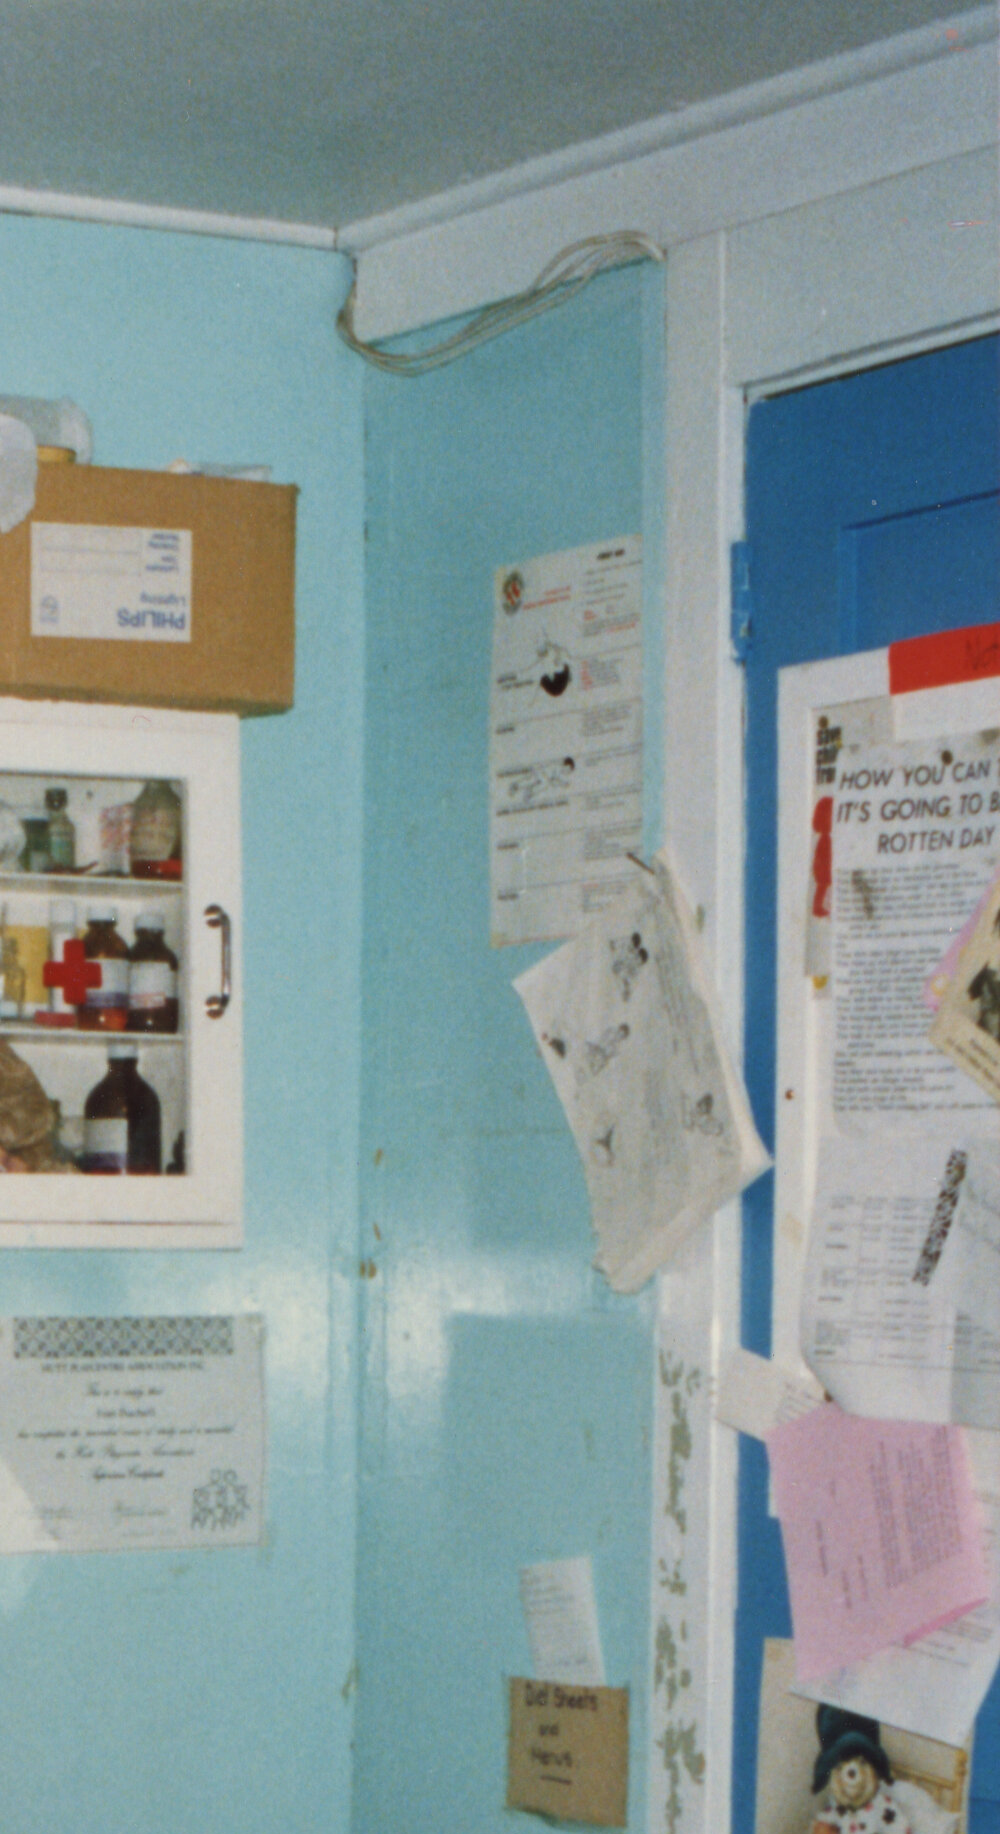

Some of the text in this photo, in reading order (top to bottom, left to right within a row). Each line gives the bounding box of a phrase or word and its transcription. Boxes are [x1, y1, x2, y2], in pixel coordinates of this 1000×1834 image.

[140, 592, 186, 606] Lighting
[117, 608, 186, 630] PHILIPS
[839, 768, 894, 790] HOW
[902, 764, 946, 787] YOU
[952, 760, 992, 783] CAN
[837, 790, 1000, 823] IT'S GOING TO B
[877, 825, 996, 854] ROTTEN DAY
